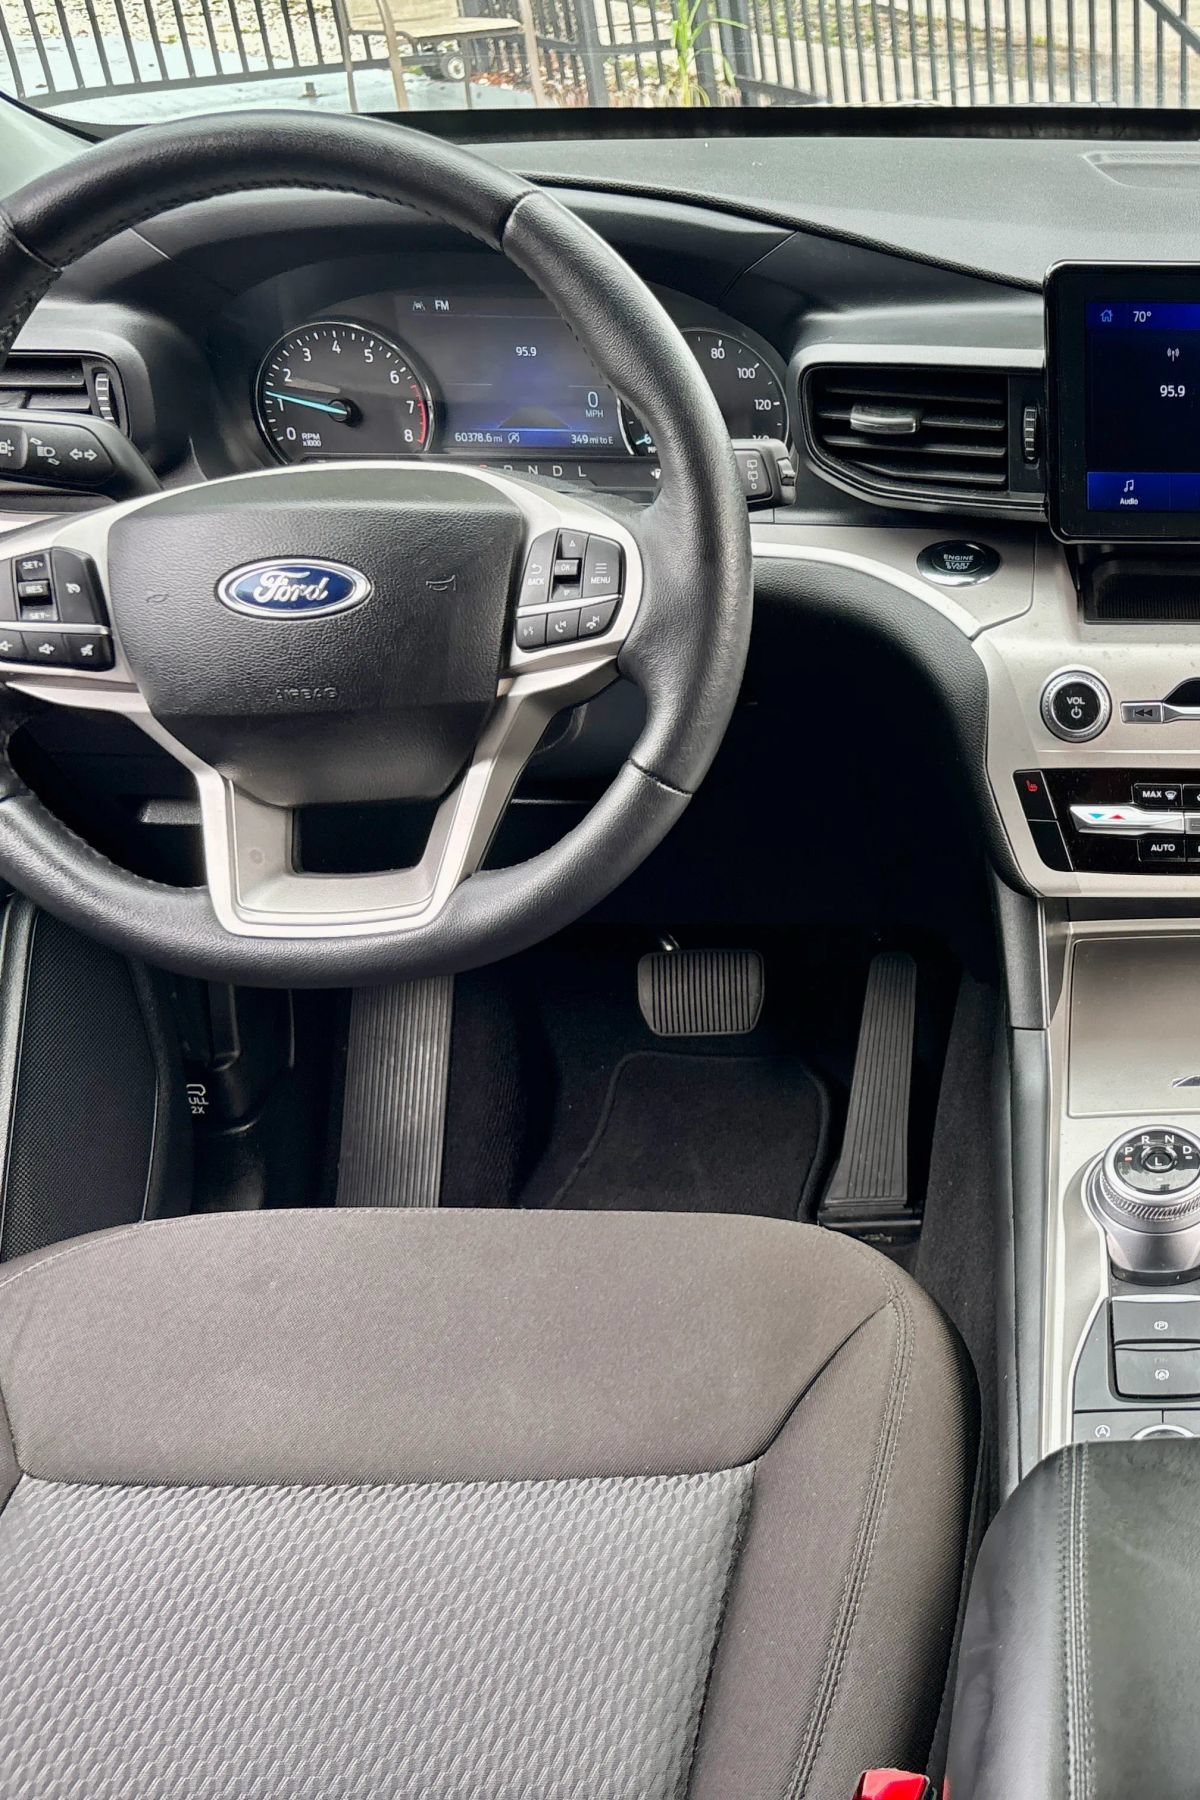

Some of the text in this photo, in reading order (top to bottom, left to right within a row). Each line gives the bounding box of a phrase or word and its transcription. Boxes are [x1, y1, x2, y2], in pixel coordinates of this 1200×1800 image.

[434, 300, 449, 311] FM
[1132, 310, 1152, 323] 70°
[332, 340, 342, 354] 4
[515, 346, 537, 357] 95.9
[303, 348, 312, 362] 3
[364, 349, 374, 363] 5
[710, 348, 725, 359] 80
[282, 369, 293, 383] 2
[390, 370, 400, 384] 6
[737, 367, 756, 379] 100
[1159, 384, 1186, 398] 95.9
[587, 391, 599, 408] 0
[754, 399, 772, 411] 120
[277, 399, 285, 412] 1
[406, 401, 415, 414] 7
[585, 409, 604, 418] MPH
[286, 427, 296, 441] 0
[301, 432, 321, 440] RPM
[403, 429, 413, 442] 8
[454, 432, 503, 443] 60378.6 mi
[571, 434, 614, 445] 349 mi to E
[528, 465, 587, 477] N D L
[1119, 497, 1139, 505] Audio
[943, 553, 974, 561] ENGINE
[561, 563, 570, 571] OK
[527, 577, 545, 586] BACK
[590, 576, 611, 585] MENU
[25, 585, 44, 594] RES
[252, 569, 330, 604] Ford
[1066, 696, 1086, 705] VOL
[1142, 790, 1162, 799] MAX
[1150, 843, 1176, 852] AUTO
[191, 1105, 205, 1114] 2X
[1141, 1135, 1150, 1145] R
[1164, 1134, 1175, 1144] N
[1124, 1146, 1134, 1155] P
[1182, 1145, 1193, 1154] D
[1154, 1156, 1163, 1166] L
